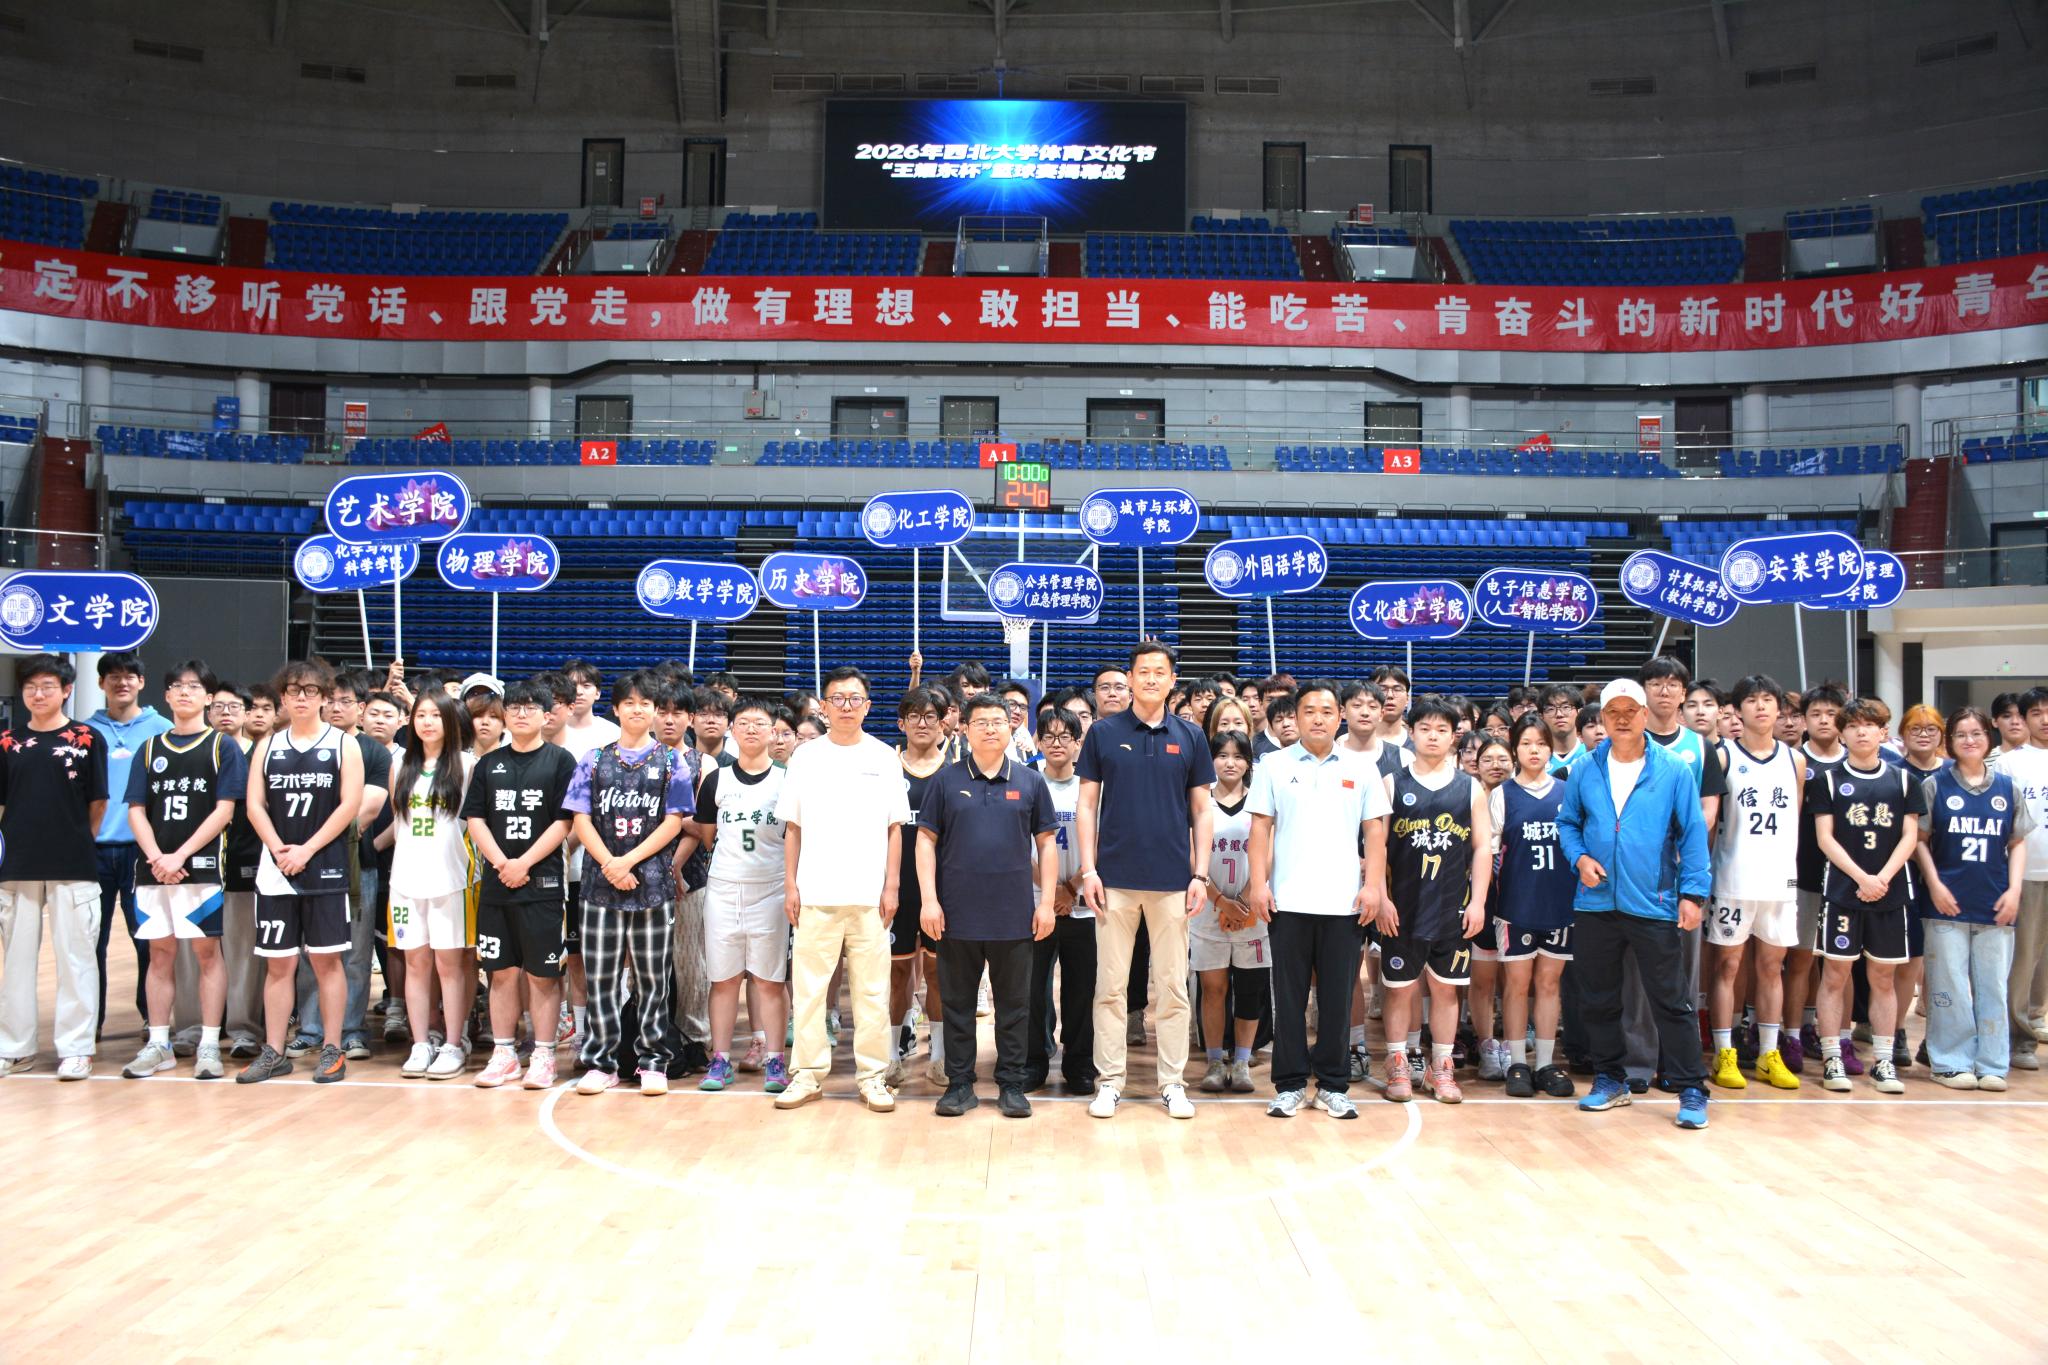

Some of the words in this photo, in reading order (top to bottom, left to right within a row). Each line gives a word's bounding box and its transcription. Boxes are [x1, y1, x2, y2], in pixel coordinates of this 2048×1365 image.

[588, 447, 610, 460] A2
[988, 449, 1009, 462] A1
[1391, 455, 1413, 468] A3
[336, 489, 458, 527] 艺术学院
[896, 504, 969, 531] 化工学院
[1119, 498, 1193, 516] 城市与环境
[1142, 517, 1171, 535] 学院
[446, 547, 549, 577] 物理学院
[1244, 549, 1322, 581] 外国语学院
[1766, 549, 1861, 583] 安莱学院
[674, 577, 754, 605] 数学学院
[769, 567, 861, 596] 历史学院
[1024, 573, 1097, 591] 公共管理学院
[1486, 577, 1588, 602] 电子信息学院
[1667, 568, 1729, 601] 计算机学院
[47, 593, 152, 630] 文学院
[1355, 596, 1465, 623] 文化遗产学院
[269, 772, 333, 789] 艺术学院
[163, 795, 189, 821] 15
[285, 792, 314, 818] 77
[495, 789, 544, 811] 数学
[599, 786, 661, 817] History
[1737, 786, 1789, 809] 信息
[722, 809, 779, 826] 化工学院
[1749, 812, 1778, 836] 24
[1845, 802, 1894, 827] 信息
[1947, 816, 2003, 836] ANLAI
[412, 817, 434, 837] 22
[506, 816, 532, 840] 23
[615, 817, 643, 837] 98
[1411, 827, 1453, 851] 城环
[1522, 821, 1559, 841] 城环
[742, 829, 755, 852] 5
[1863, 831, 1877, 850] 3
[1961, 836, 1988, 863] 21
[1531, 845, 1554, 870] 31
[1222, 858, 1235, 884] 7
[393, 906, 409, 925] 22
[1719, 907, 1742, 926] 24
[1837, 915, 1849, 933] 3
[259, 919, 286, 944] 77
[478, 934, 501, 960] 23
[1248, 939, 1263, 963] 7
